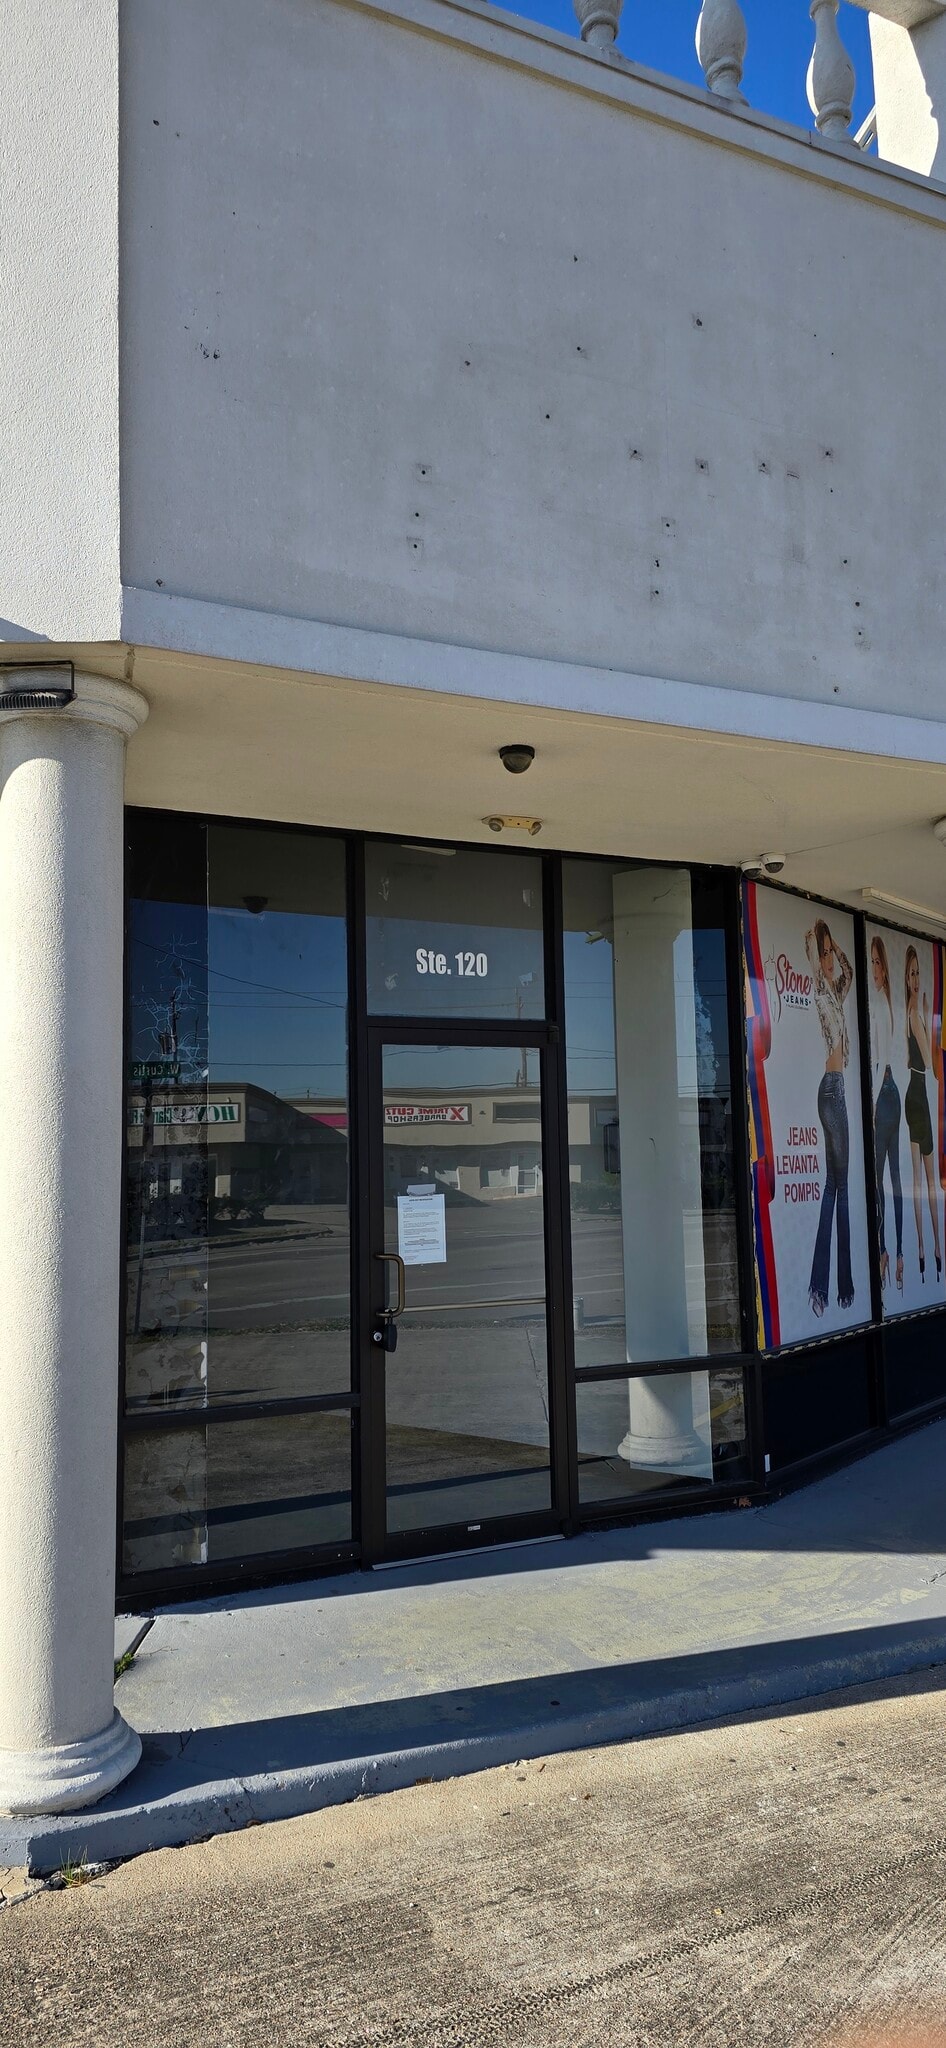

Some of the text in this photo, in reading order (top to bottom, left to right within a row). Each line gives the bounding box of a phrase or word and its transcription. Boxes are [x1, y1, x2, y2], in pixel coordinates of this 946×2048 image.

[416, 948, 488, 977] Ste. 120
[777, 953, 812, 996] Stone
[786, 995, 808, 1006] JEANS
[787, 1127, 818, 1146] JEANS
[776, 1155, 819, 1174] LEVANTA
[784, 1182, 820, 1203] POMPIS
